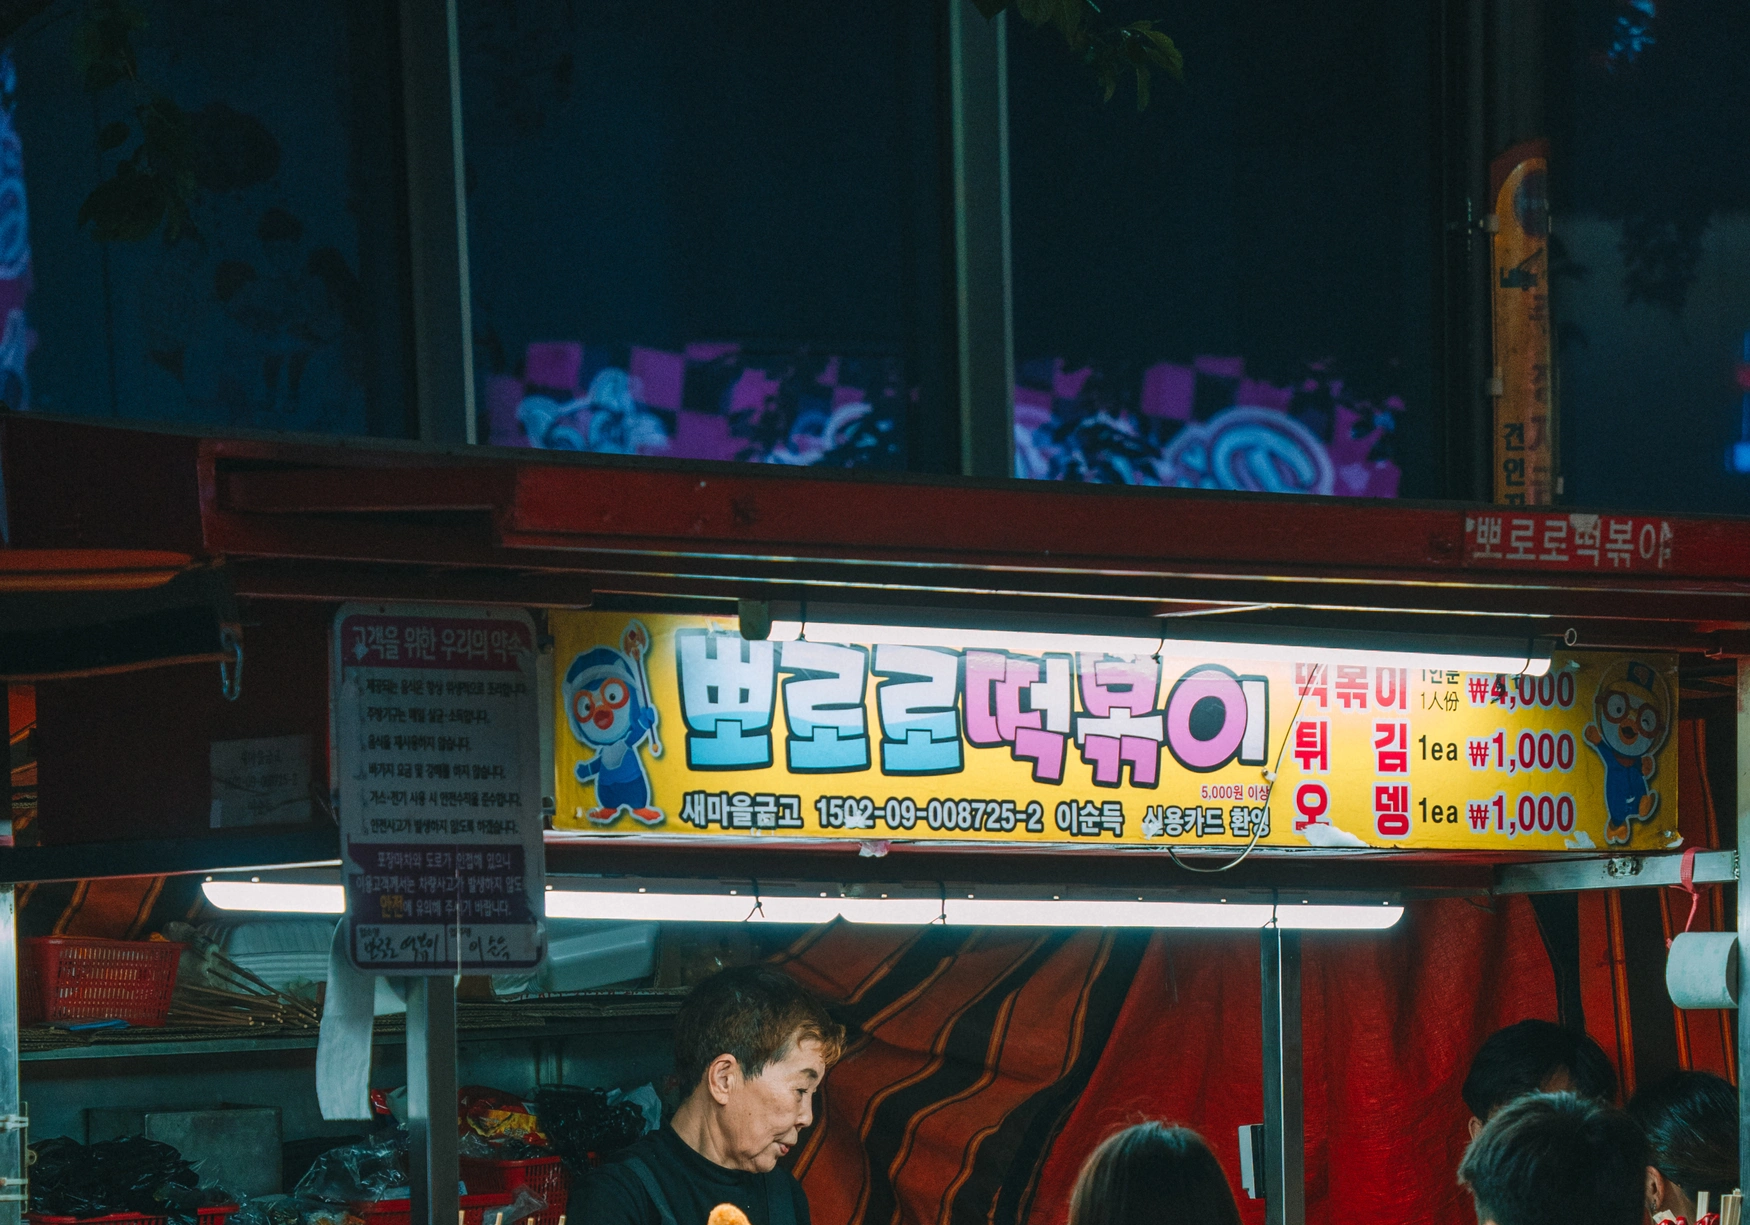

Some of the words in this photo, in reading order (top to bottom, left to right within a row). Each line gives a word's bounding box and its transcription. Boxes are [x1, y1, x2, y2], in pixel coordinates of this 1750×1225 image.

[403, 626, 437, 660] 위한
[441, 628, 488, 661] 우리의
[1418, 734, 1458, 761] 1ea
[1468, 732, 1574, 773] ₩1,000
[1201, 784, 1244, 800] 5,000원
[815, 795, 1044, 833] 1502-09-008725-2
[1055, 799, 1125, 837] 이순득
[1418, 797, 1458, 823] 1ea
[1468, 795, 1574, 836] ₩1,000
